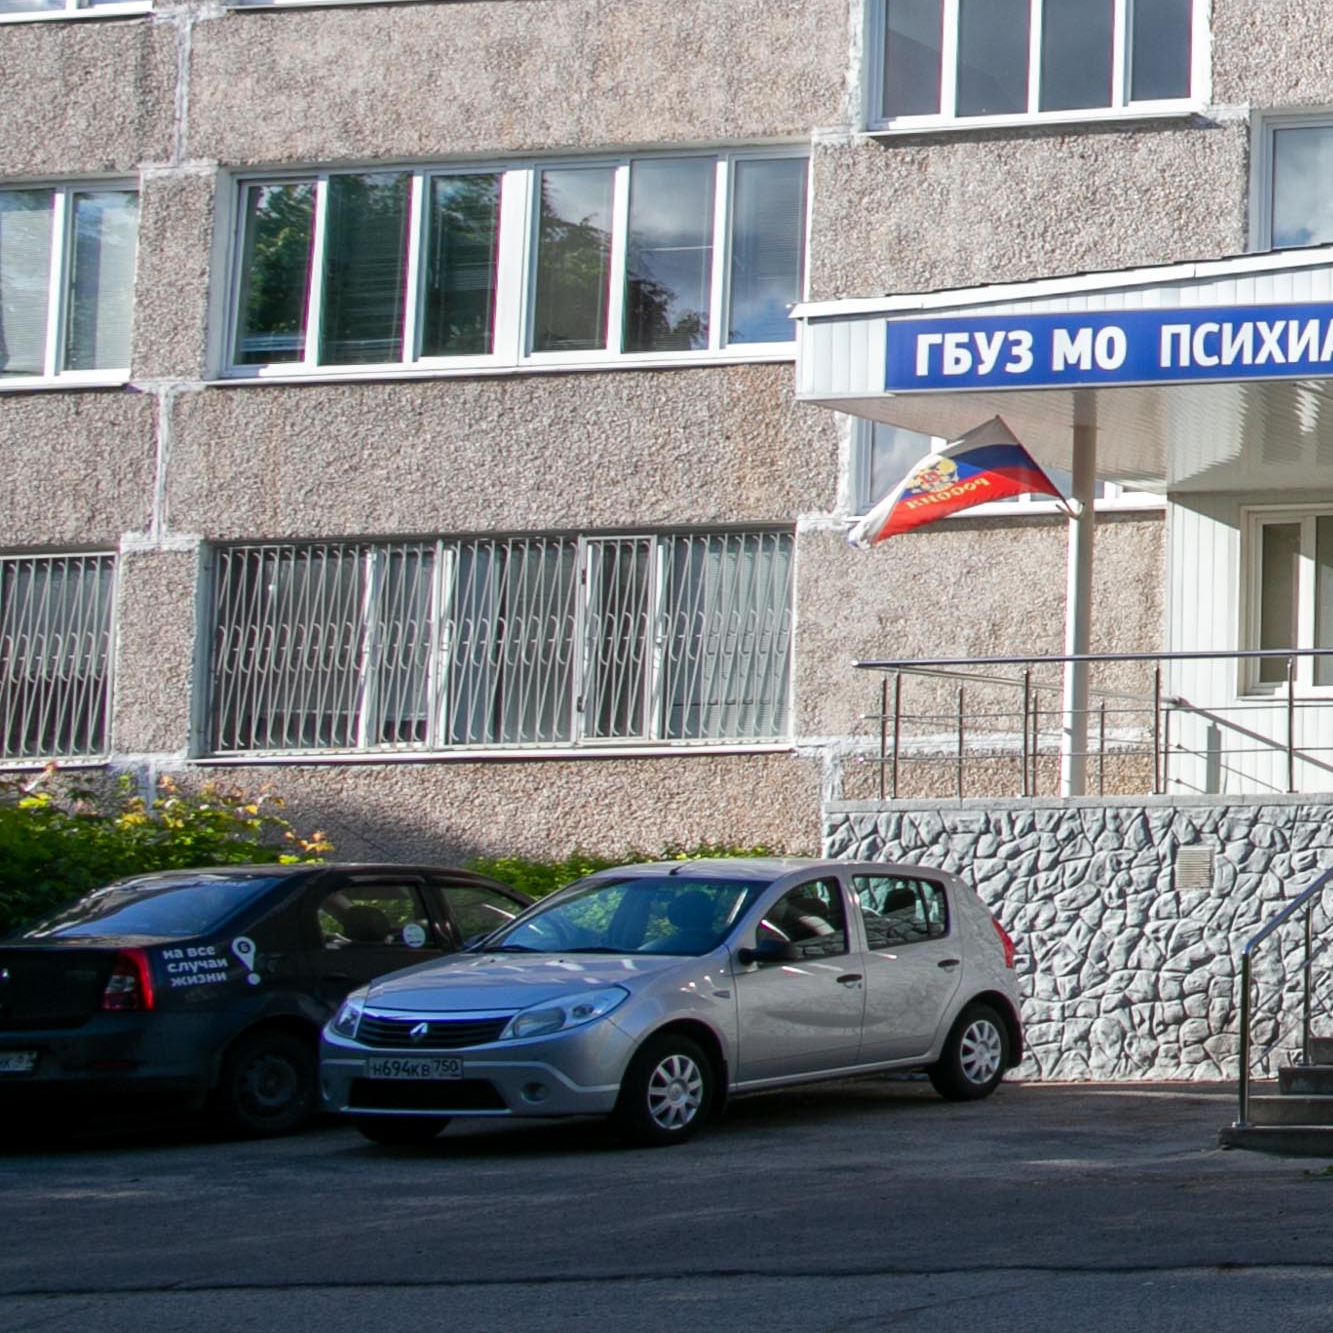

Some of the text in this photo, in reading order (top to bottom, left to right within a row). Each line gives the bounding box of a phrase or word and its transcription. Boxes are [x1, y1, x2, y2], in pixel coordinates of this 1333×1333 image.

[915, 329, 1034, 377] ГБУЗ
[1051, 325, 1128, 372] МО
[162, 945, 216, 960] на все
[167, 958, 228, 973] случаи
[171, 972, 227, 987] жизни
